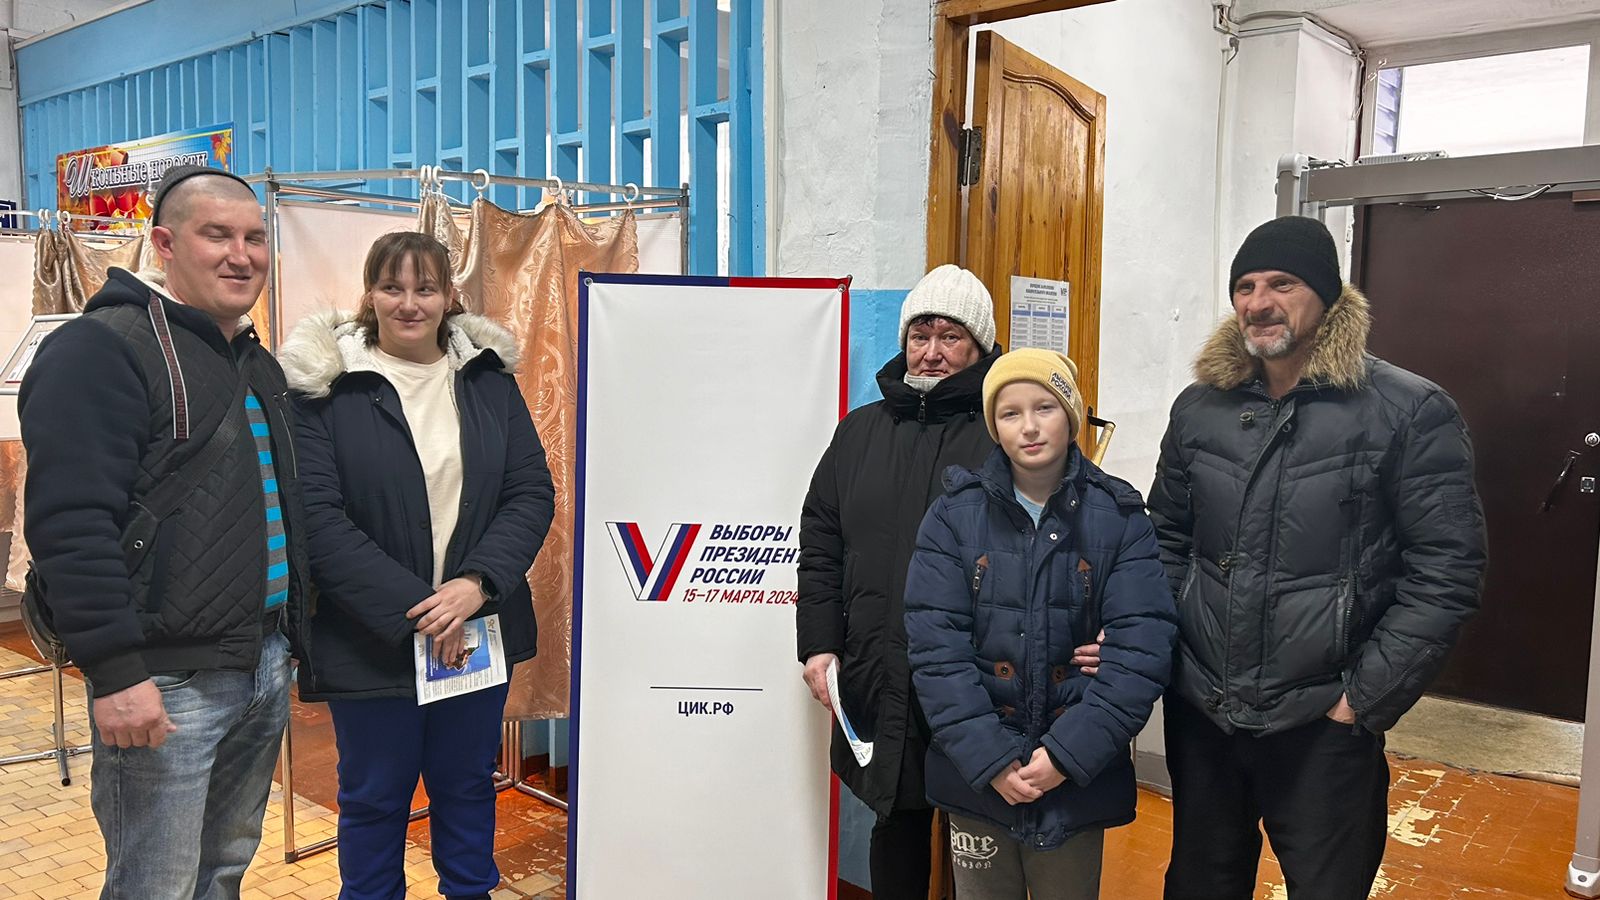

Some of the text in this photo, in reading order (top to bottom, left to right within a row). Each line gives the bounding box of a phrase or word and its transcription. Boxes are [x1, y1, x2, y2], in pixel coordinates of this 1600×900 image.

[65, 154, 148, 198] Школьные
[709, 524, 793, 542] ВЫБОРЫ
[689, 568, 766, 585] РОССИИ
[721, 589, 765, 604] МАРТА
[766, 590, 799, 605] 2024
[678, 701, 734, 717] ЦИК.РФ
